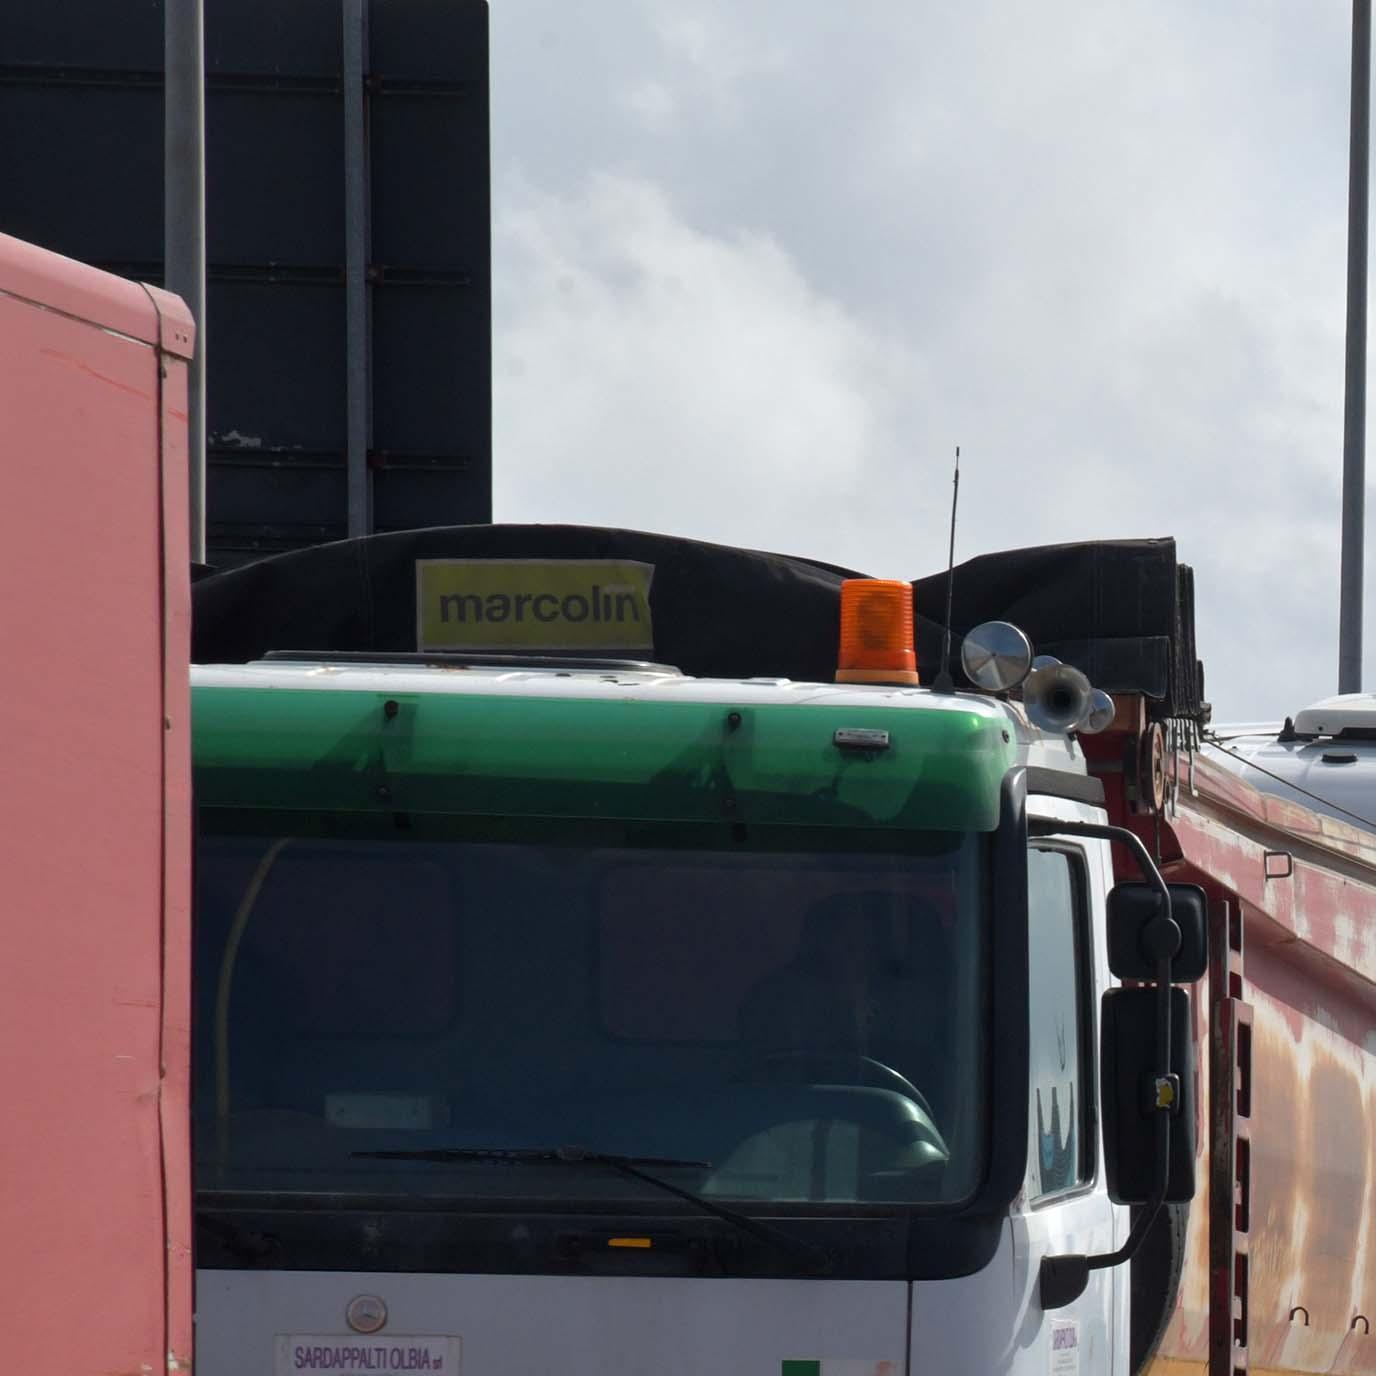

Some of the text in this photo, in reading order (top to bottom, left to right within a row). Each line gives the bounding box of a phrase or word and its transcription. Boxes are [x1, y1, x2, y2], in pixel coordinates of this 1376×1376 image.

[439, 584, 640, 623] marcolin
[294, 1346, 387, 1370] SARDAPPALTI
[390, 1347, 431, 1370] OLBIA
